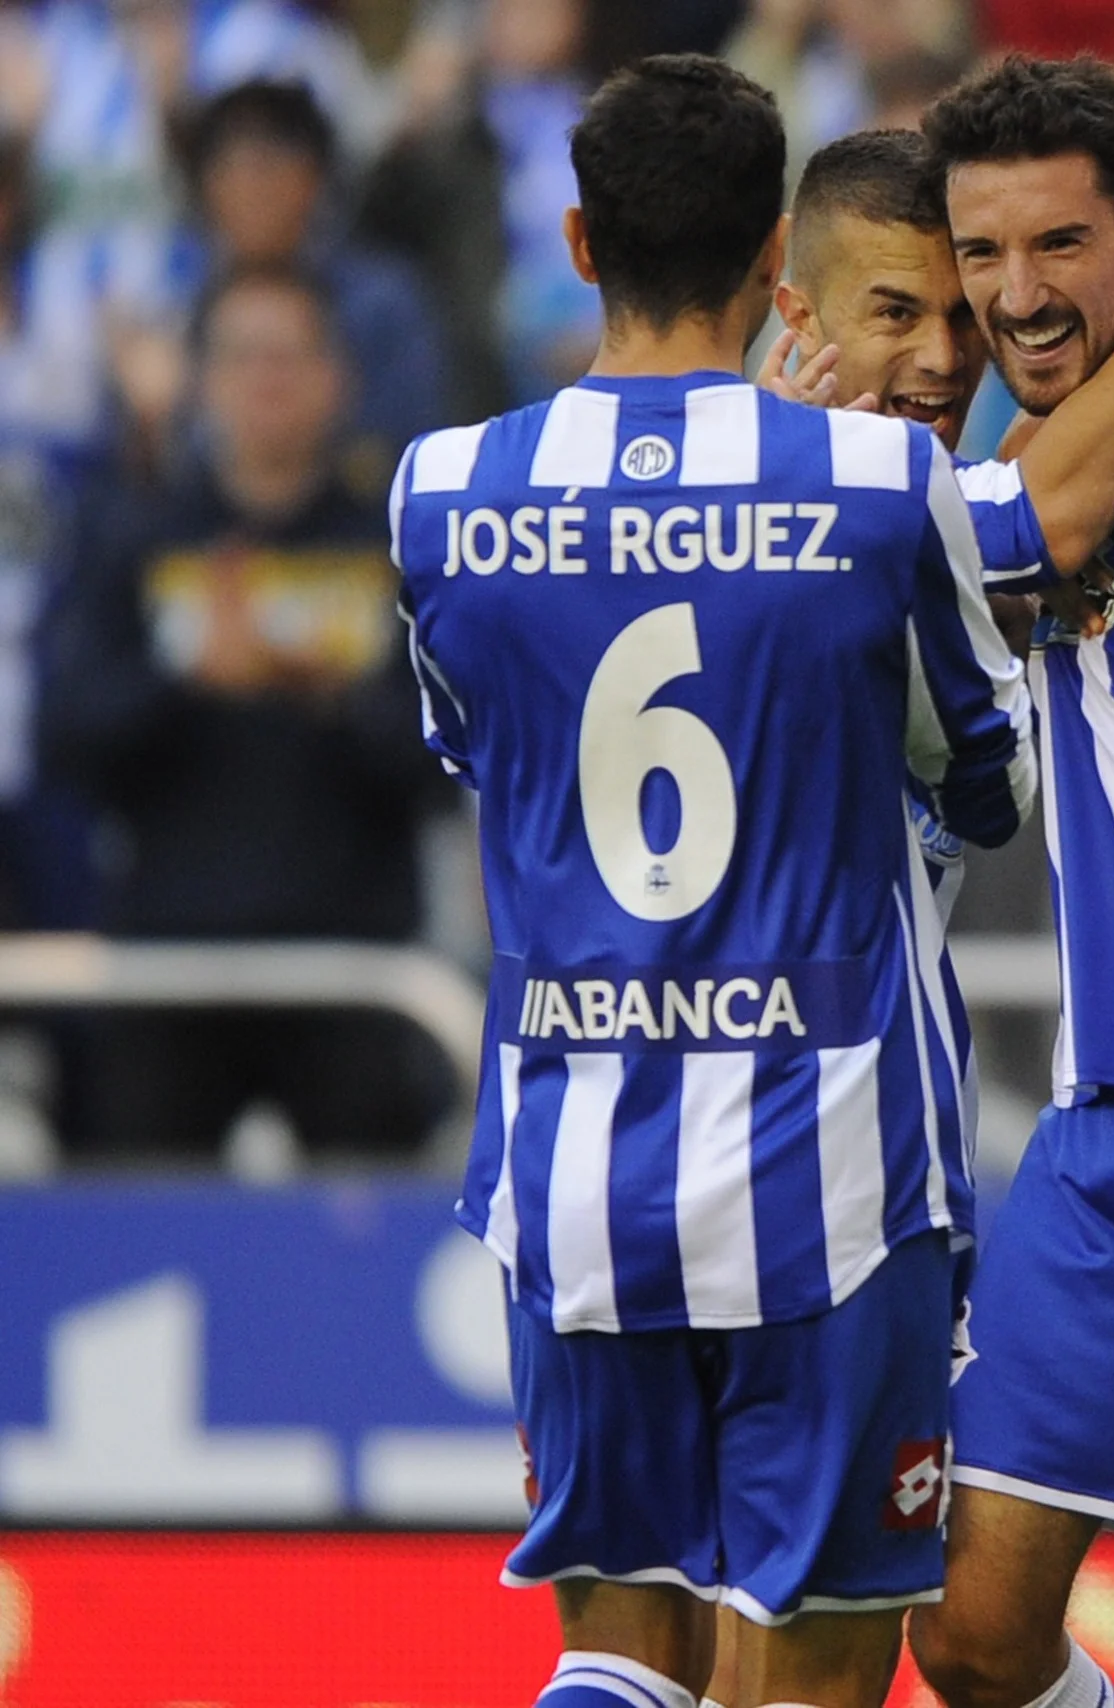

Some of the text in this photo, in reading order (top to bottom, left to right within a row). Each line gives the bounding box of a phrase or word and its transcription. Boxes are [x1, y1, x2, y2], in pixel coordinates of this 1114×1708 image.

[444, 486, 852, 577] JOSÉ RGUEZ.
[578, 600, 738, 922] 6
